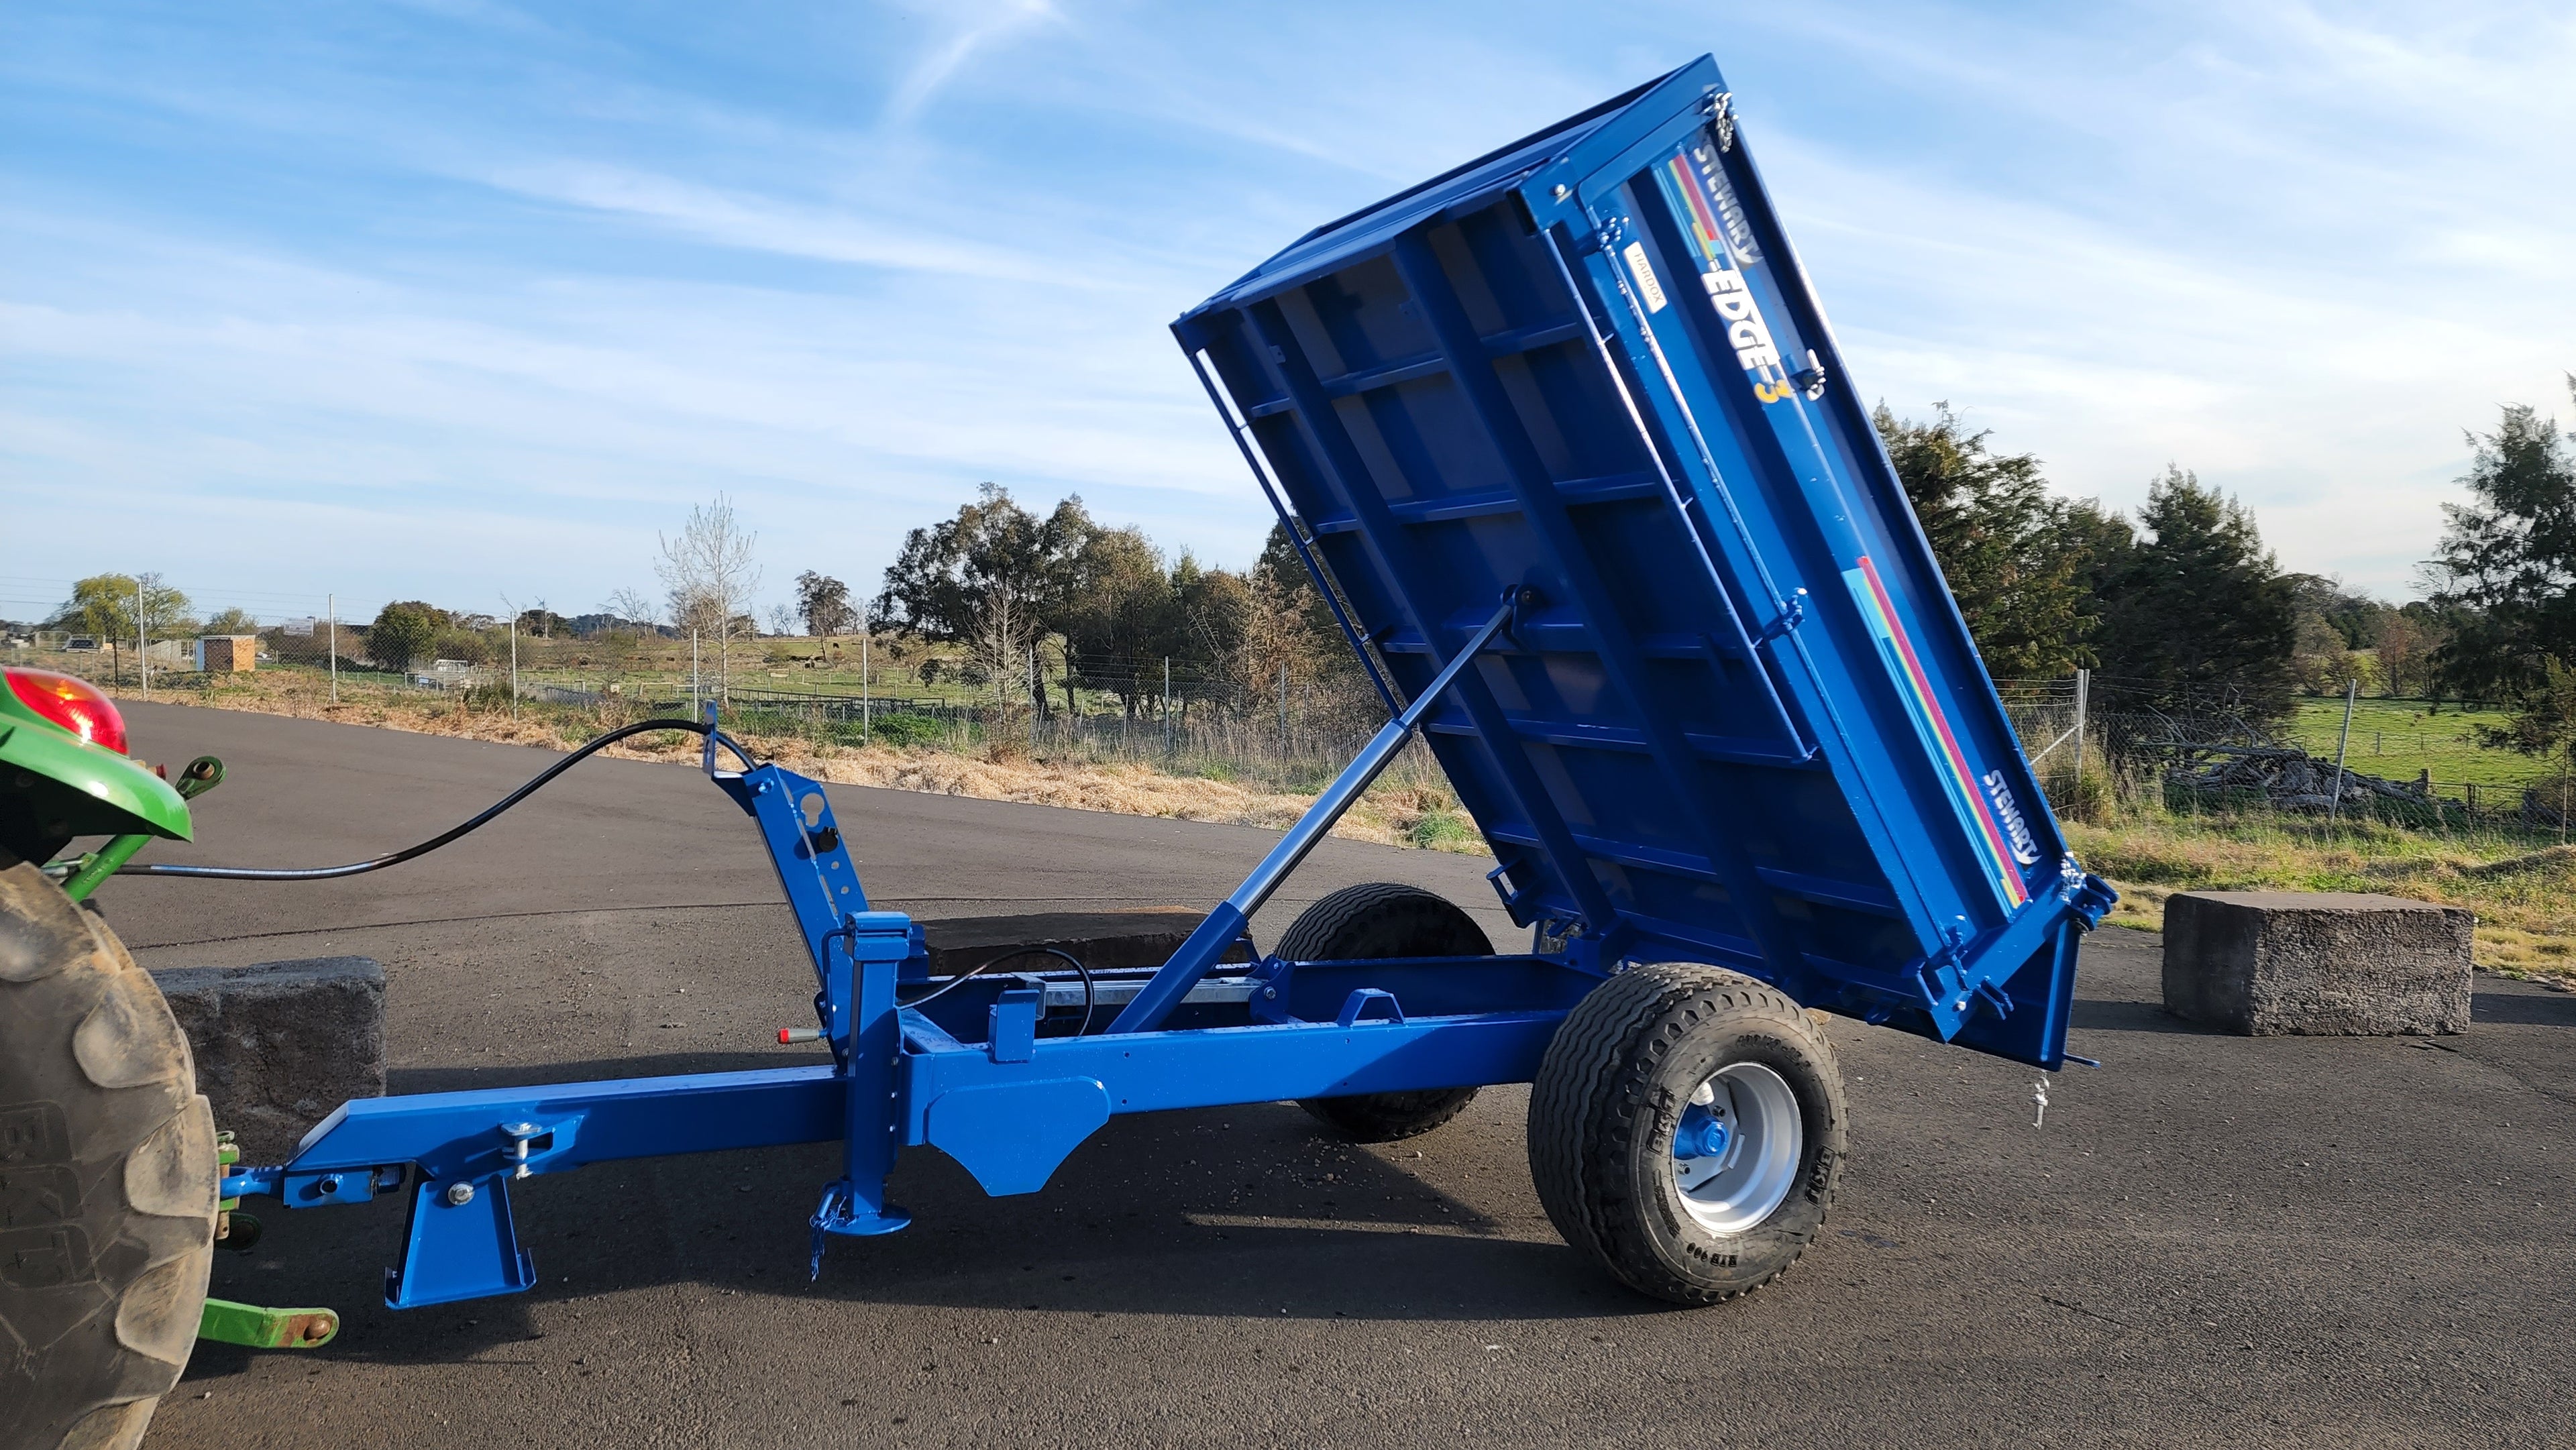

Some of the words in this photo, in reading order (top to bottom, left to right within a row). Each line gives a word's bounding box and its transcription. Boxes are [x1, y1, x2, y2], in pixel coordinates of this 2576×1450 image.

[1694, 144, 1764, 264] STEWART
[1634, 253, 1664, 302] HARDOX
[1983, 769, 2042, 865] STEWART
[1805, 1144, 1836, 1209] BKT
